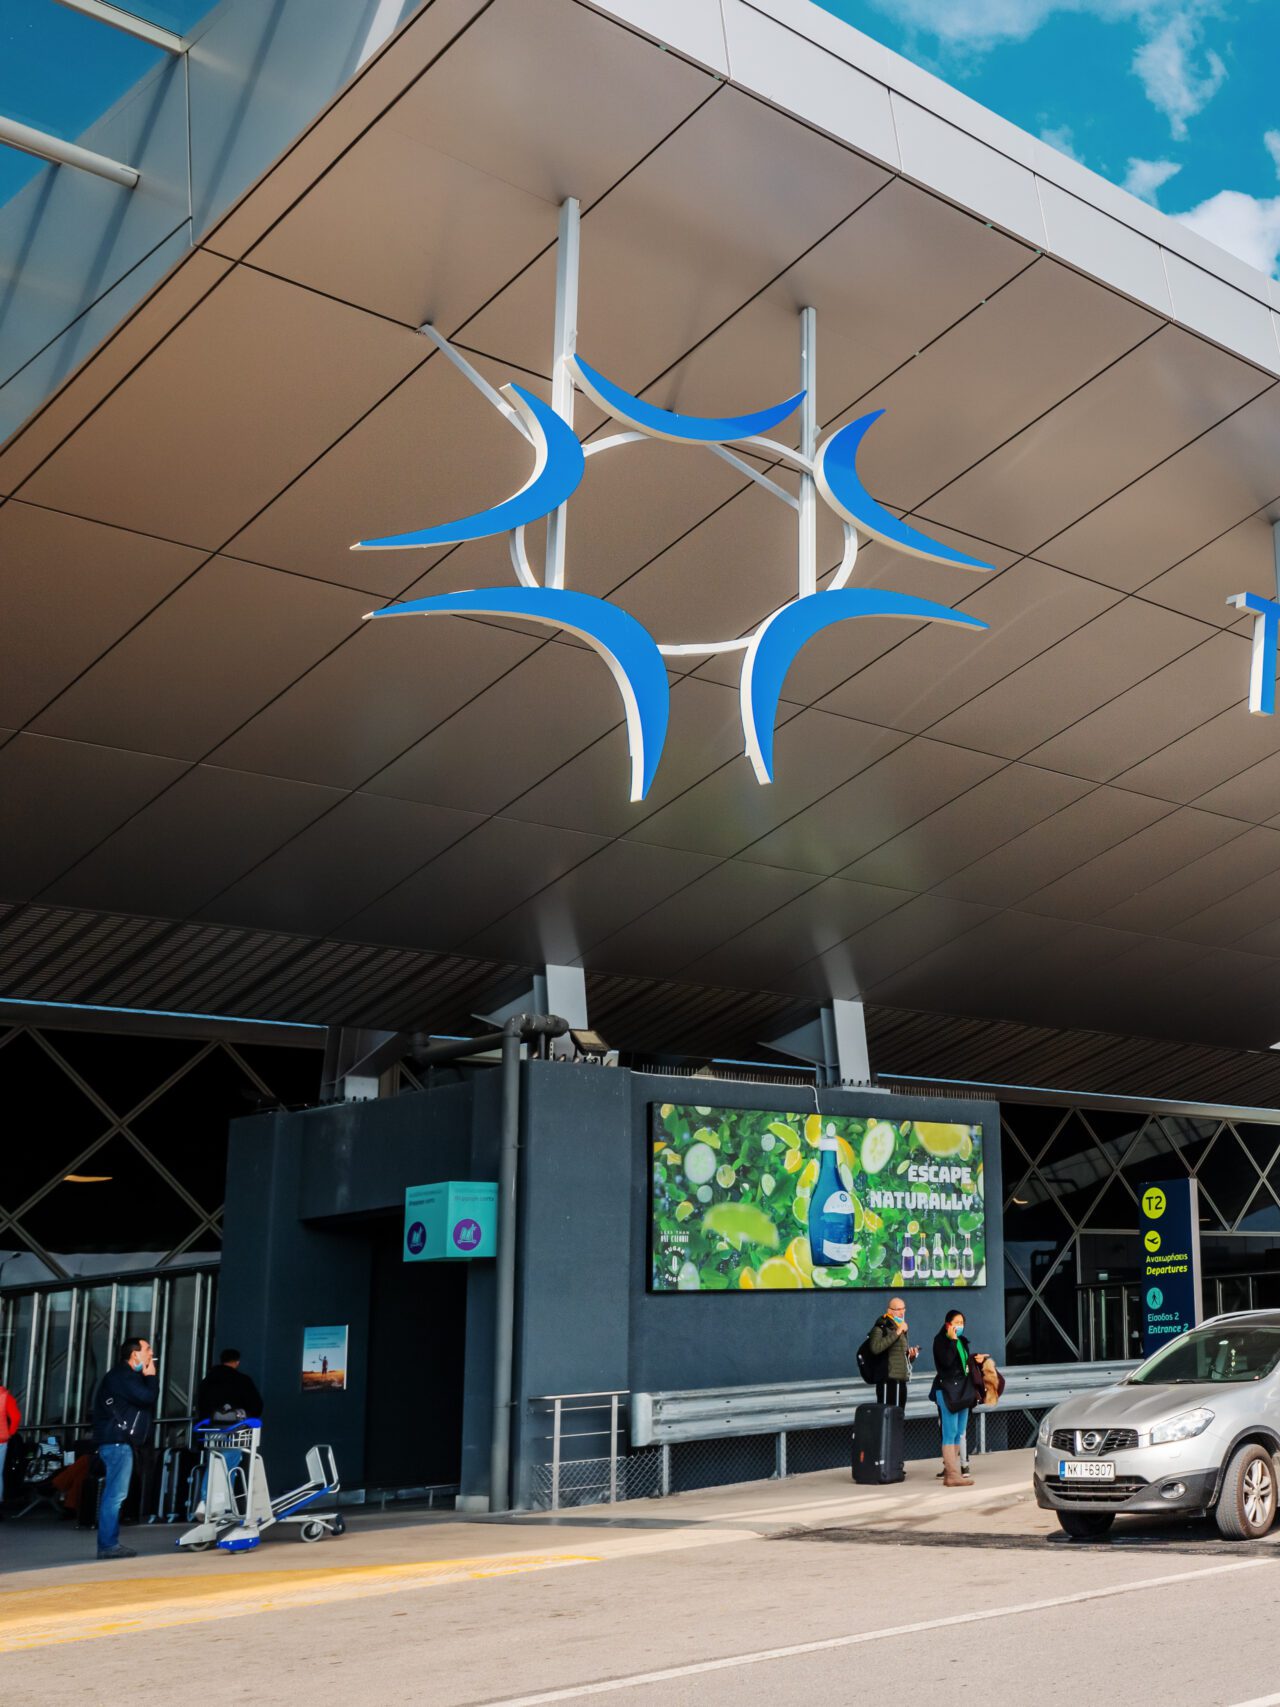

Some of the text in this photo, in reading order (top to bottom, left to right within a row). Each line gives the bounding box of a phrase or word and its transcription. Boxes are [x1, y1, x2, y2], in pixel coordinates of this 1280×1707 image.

[908, 1165, 972, 1184] ESCAPE
[870, 1191, 973, 1210] NATURALLY
[1145, 1196, 1163, 1211] T2
[1146, 1265, 1188, 1276] Departures
[1174, 1312, 1180, 1320] 2
[1148, 1323, 1189, 1335] Entrance 2
[1067, 1464, 1112, 1476] NKI-6907
